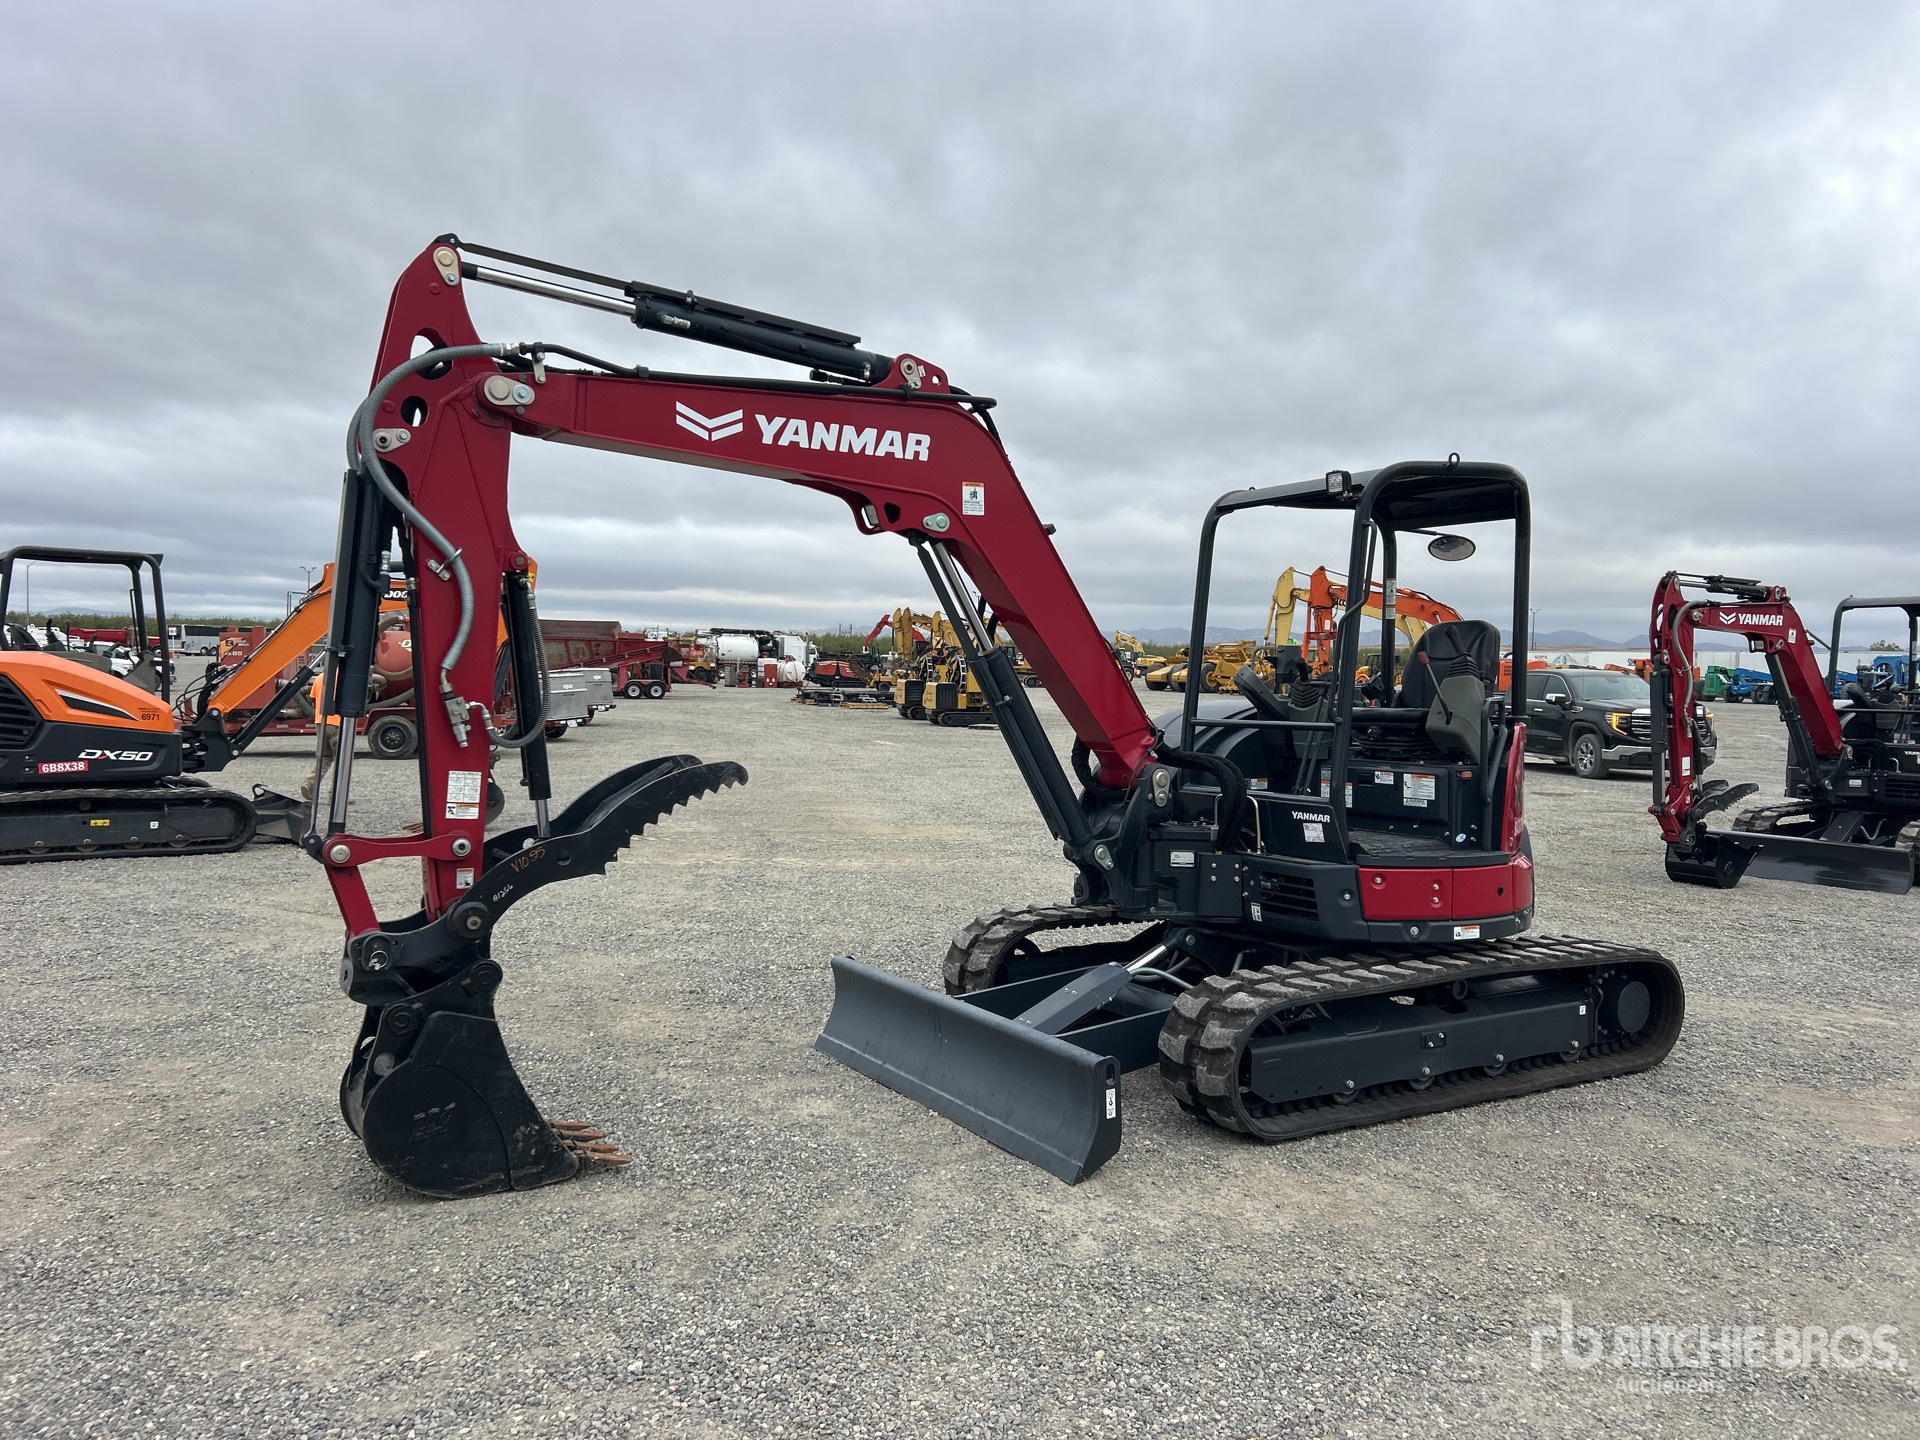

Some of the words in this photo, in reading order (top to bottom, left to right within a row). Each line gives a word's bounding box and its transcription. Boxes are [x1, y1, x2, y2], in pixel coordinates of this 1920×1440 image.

[755, 414, 931, 461] YANMAR
[1738, 613, 1784, 626] YANMAR
[141, 713, 160, 721] 6971
[78, 749, 153, 761] DX50
[42, 762, 85, 773] 6B8X38
[1291, 811, 1330, 823] YANMAR
